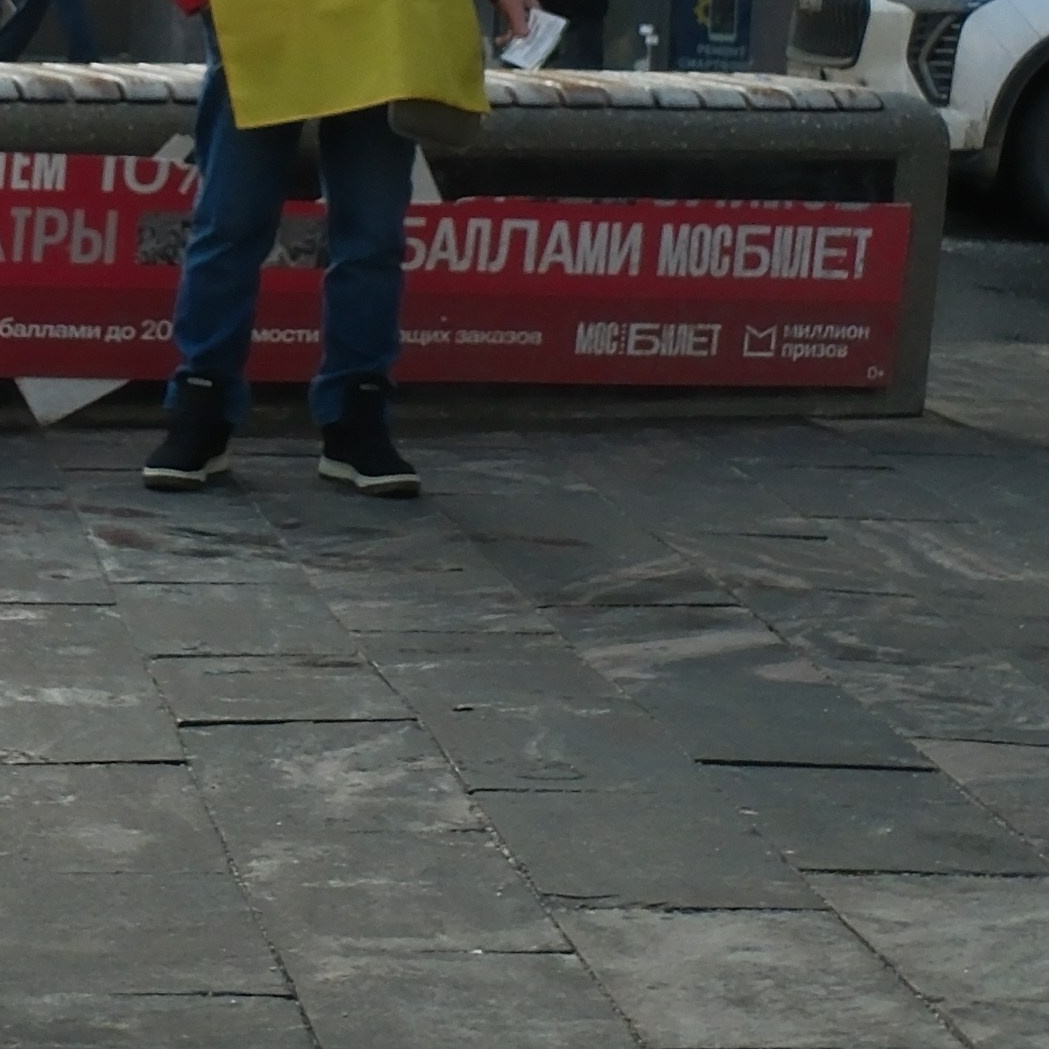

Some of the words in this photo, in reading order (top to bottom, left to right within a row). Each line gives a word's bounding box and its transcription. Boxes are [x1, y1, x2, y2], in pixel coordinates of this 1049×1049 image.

[402, 216, 643, 277] БАЛЛАМИ
[656, 223, 872, 280] МОСБИЛЕТ
[104, 323, 136, 342] до
